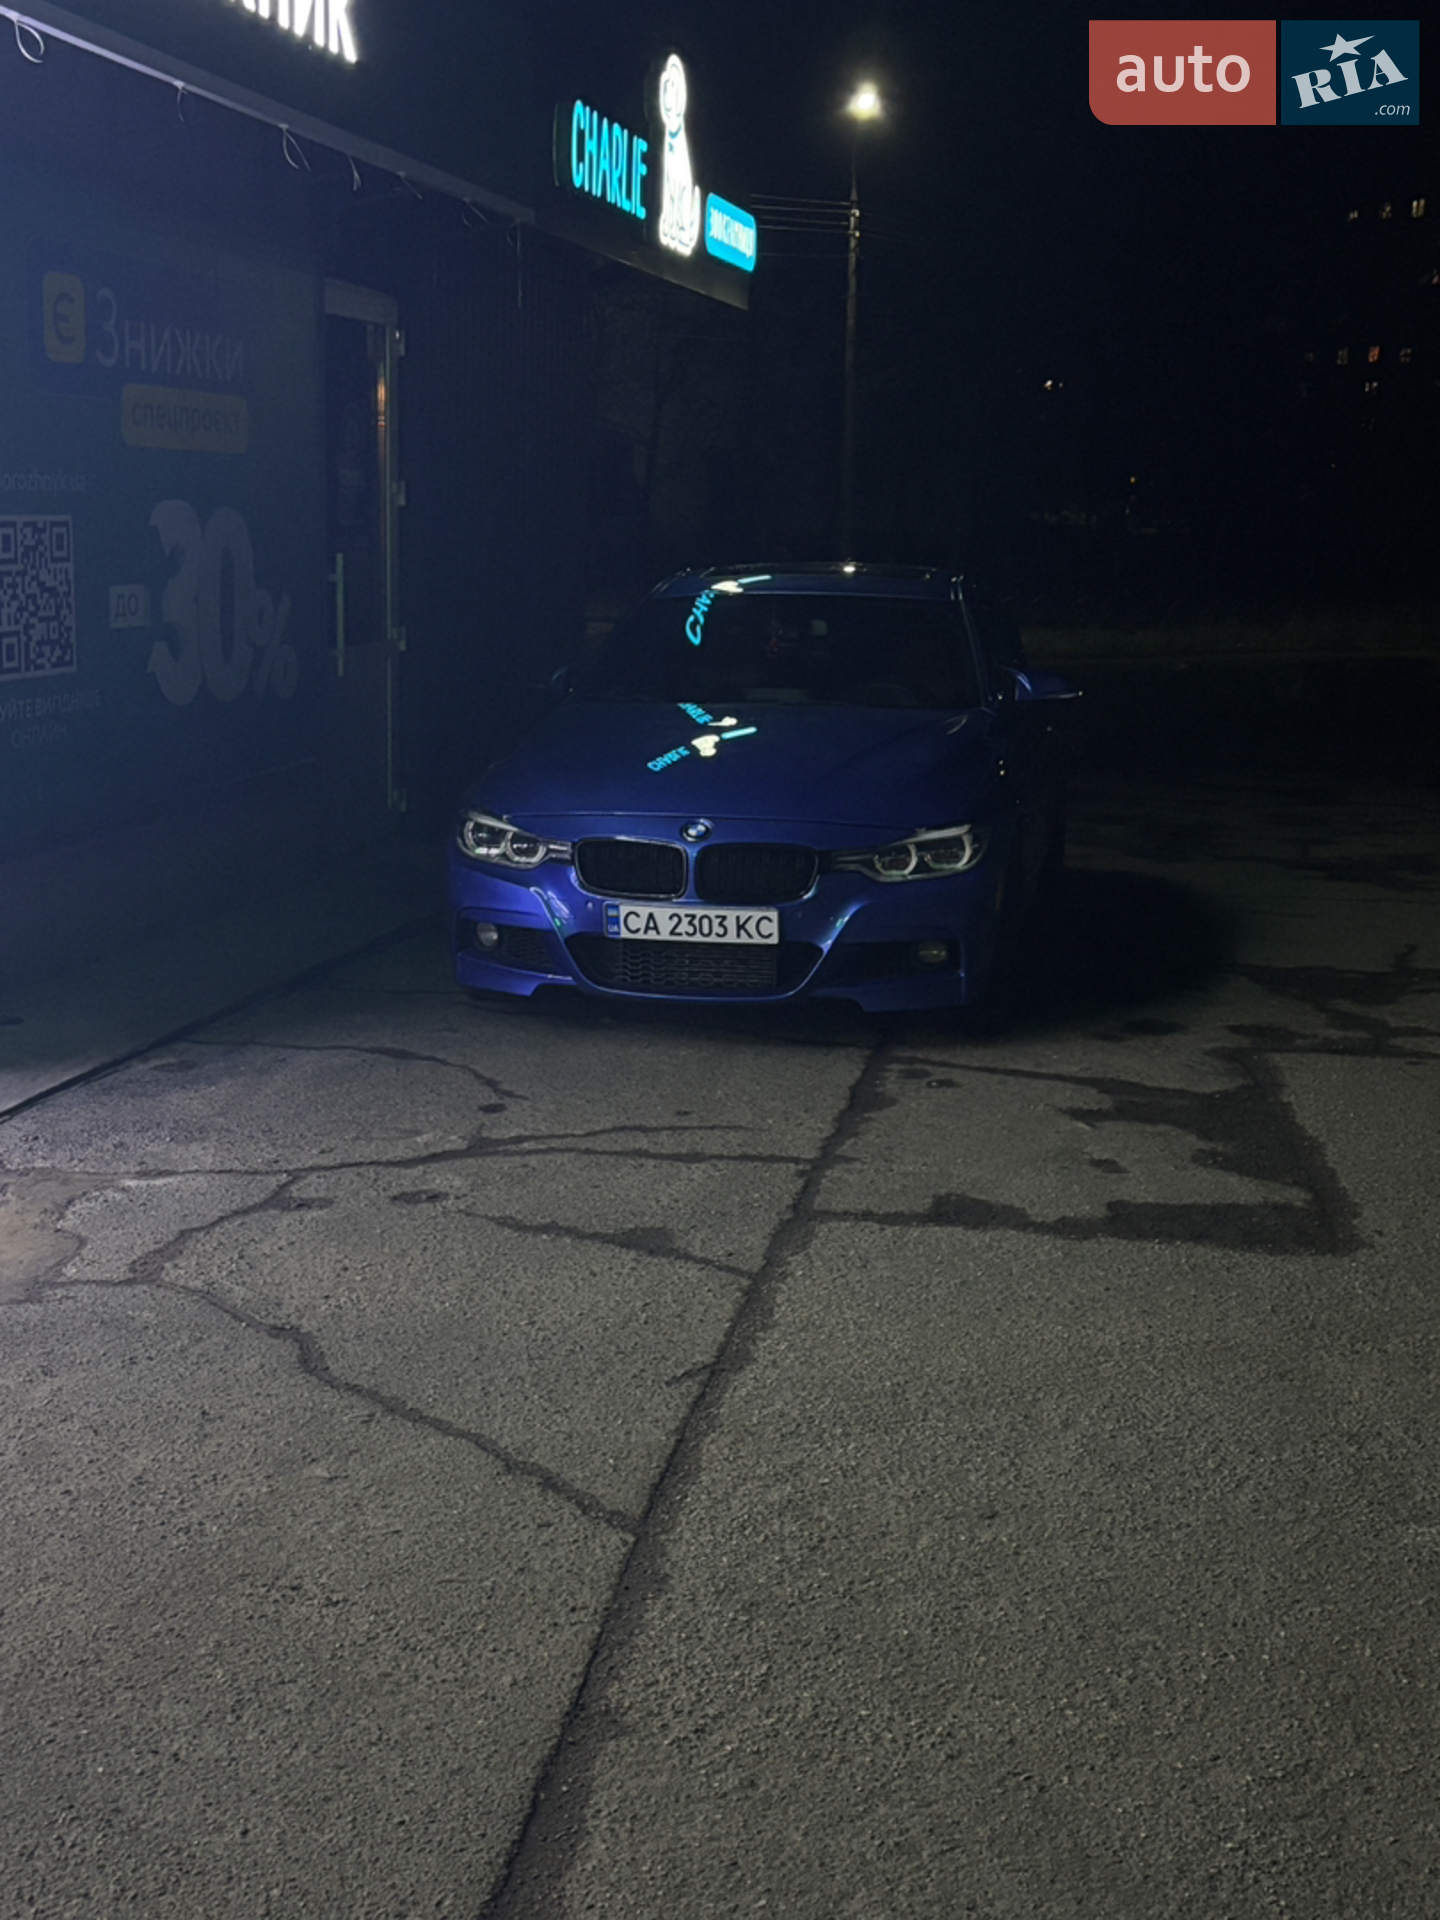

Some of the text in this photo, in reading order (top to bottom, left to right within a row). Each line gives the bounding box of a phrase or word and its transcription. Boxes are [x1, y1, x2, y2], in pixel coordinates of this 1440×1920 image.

[571, 99, 648, 220] CHARLIE
[146, 499, 299, 706] 30%
[623, 911, 773, 939] CA 2303 KC
